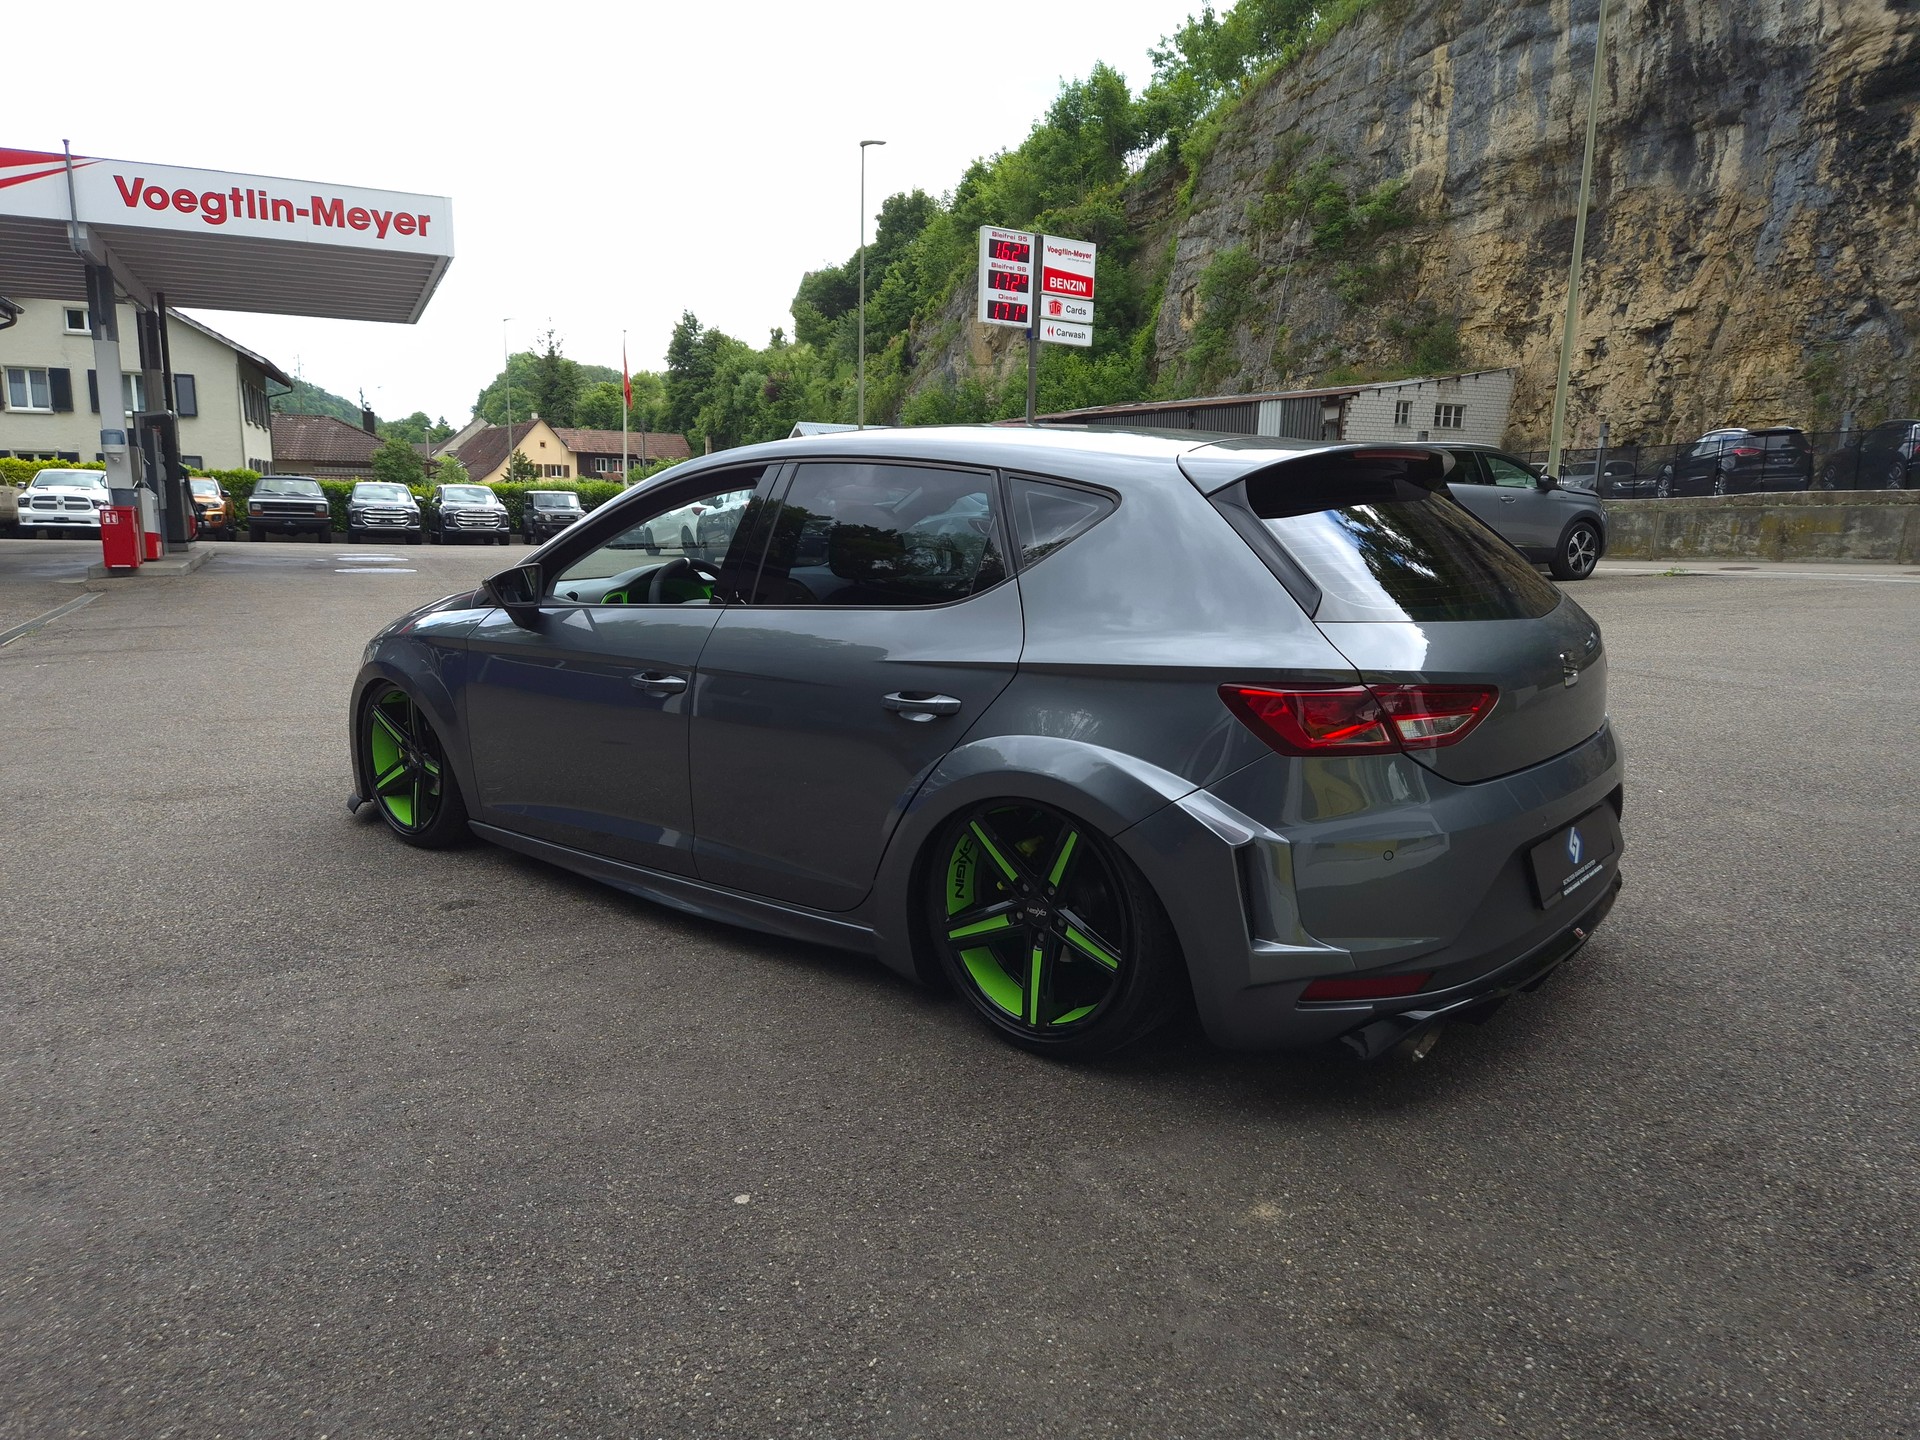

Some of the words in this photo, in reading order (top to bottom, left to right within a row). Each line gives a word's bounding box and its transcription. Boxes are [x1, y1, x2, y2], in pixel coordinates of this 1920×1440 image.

[113, 175, 431, 239] Voegtlin-Meyer
[991, 231, 1016, 241] Bleifrei
[1046, 245, 1092, 260] Voegtlin-Meyer
[991, 262, 1015, 271] Bleifrei
[1049, 277, 1087, 293] BENZIN
[998, 293, 1019, 302] Diesel
[1065, 305, 1087, 315] Cards
[1056, 328, 1086, 340] Carwash
